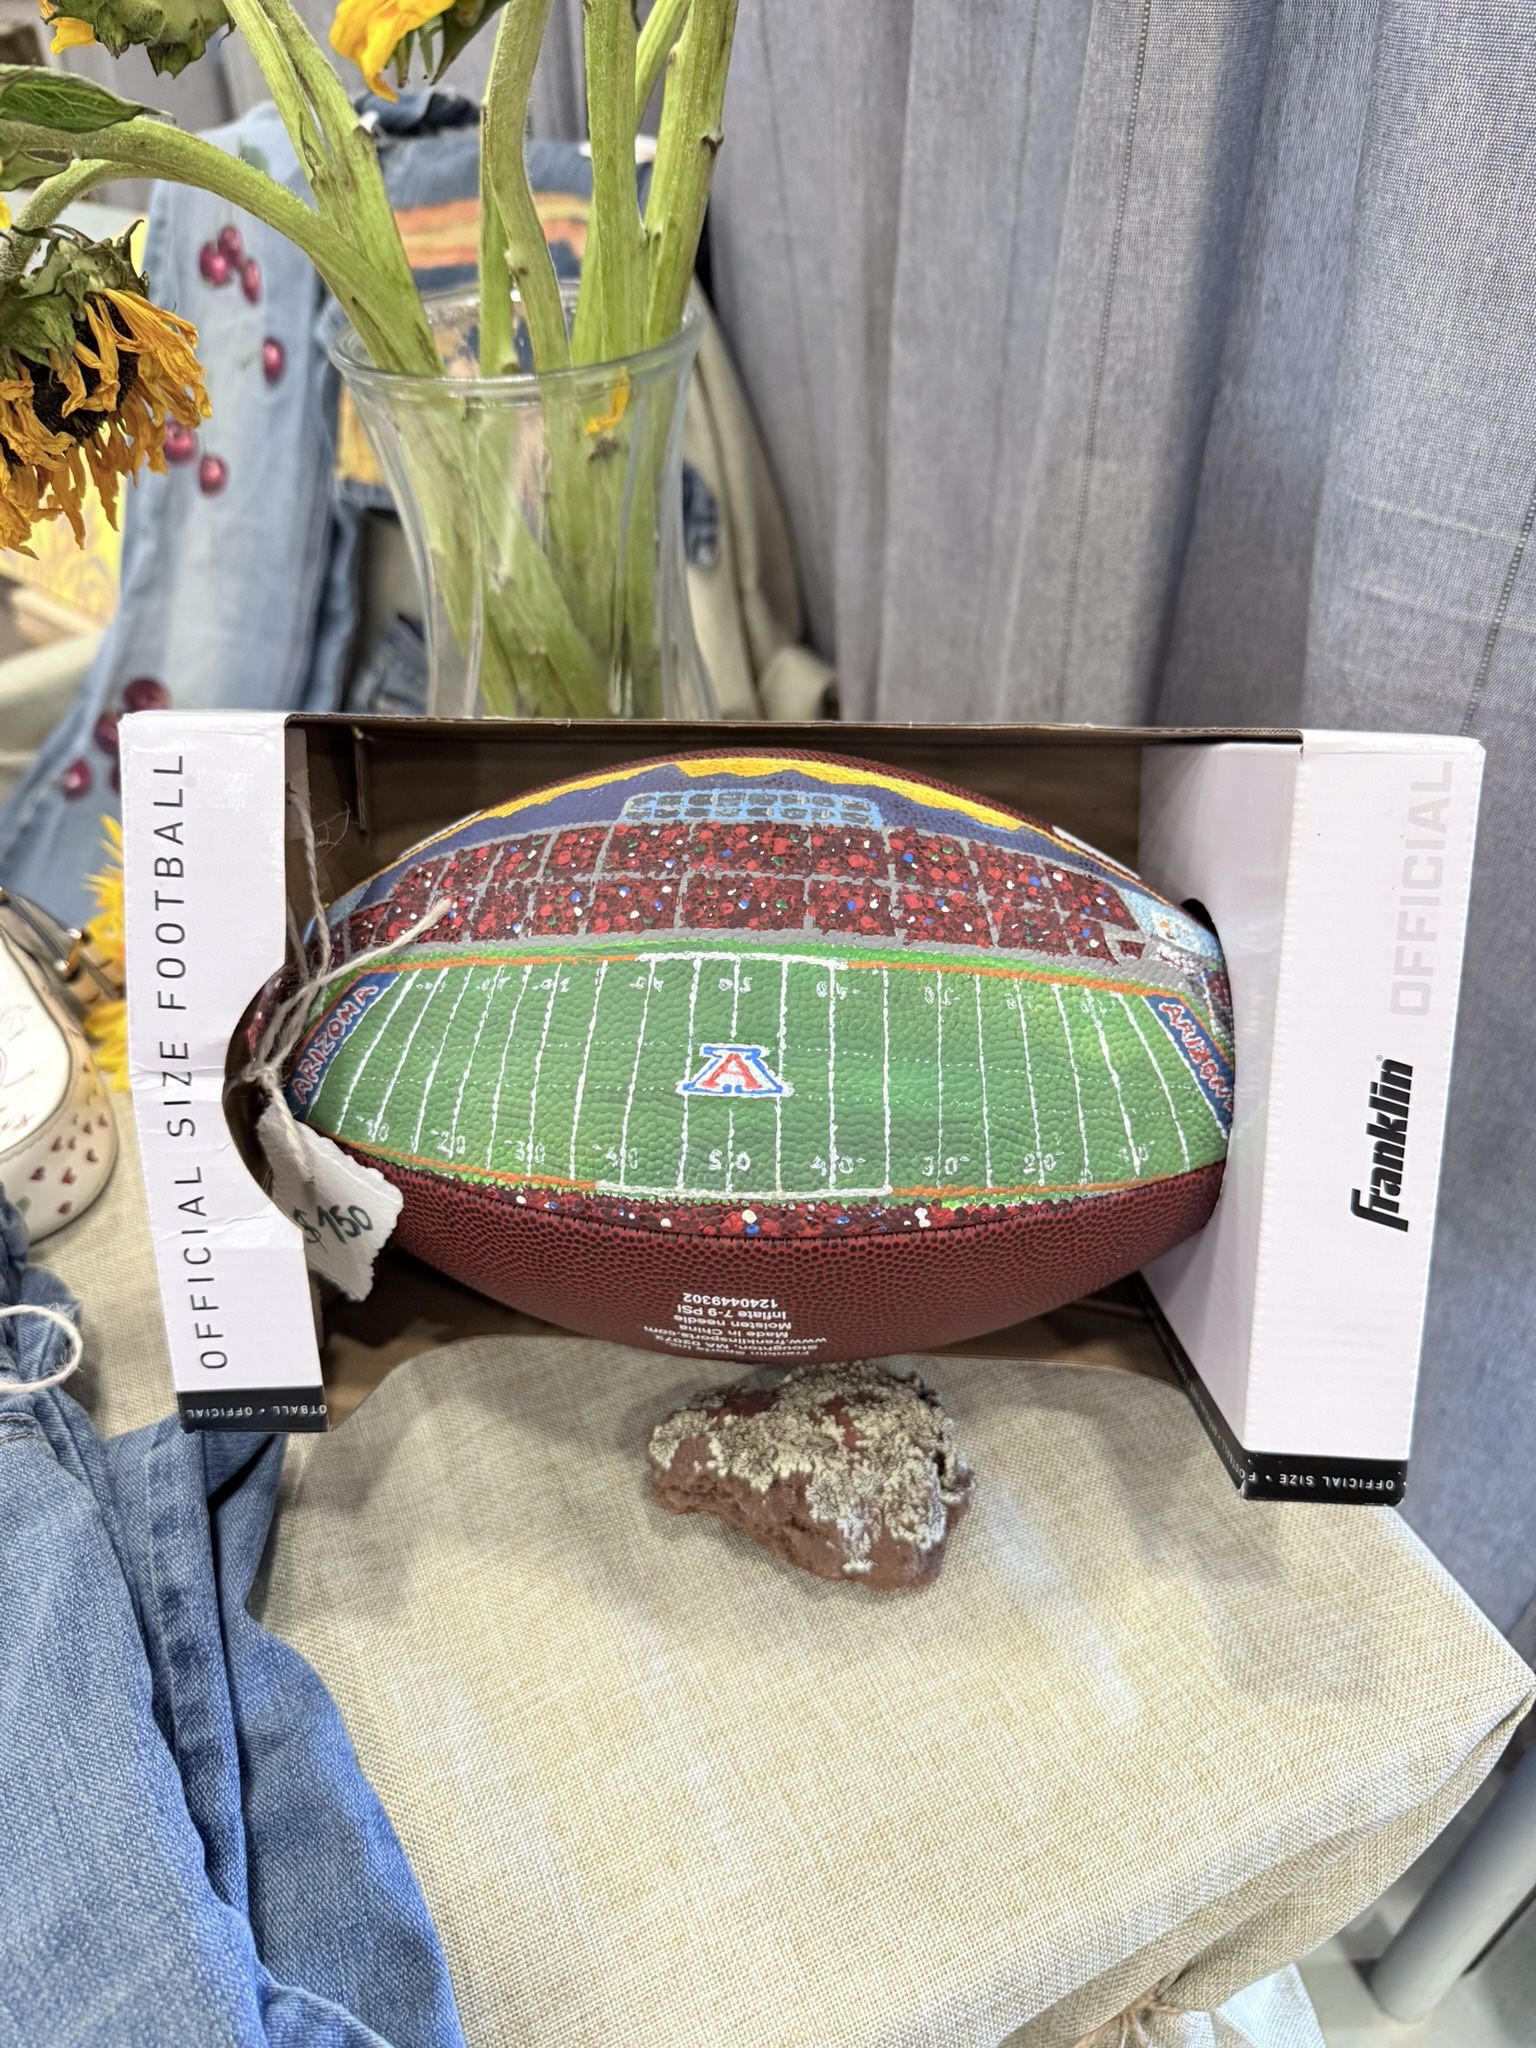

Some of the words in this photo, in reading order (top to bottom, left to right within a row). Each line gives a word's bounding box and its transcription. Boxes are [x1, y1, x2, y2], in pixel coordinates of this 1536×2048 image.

[153, 755, 189, 1011] FOOTBALL
[1390, 761, 1453, 1016] OFFICIAL
[676, 1043, 794, 1099] A
[159, 1041, 196, 1137] SIZE
[708, 1149, 751, 1171] 50
[922, 1157, 959, 1176] 30
[299, 1204, 373, 1253] $150
[175, 1166, 228, 1370] OFFICIAL
[682, 1292, 779, 1309] 1240449302
[677, 1303, 704, 1316] PSI
[707, 1307, 734, 1319] 7-9
[737, 1310, 787, 1321] Inflate
[673, 1314, 726, 1327] needle
[730, 1320, 792, 1331] Moisten
[643, 1325, 827, 1345] www.franklinsports.com
[679, 1323, 724, 1336] China
[746, 1331, 789, 1339] Made
[186, 1406, 254, 1418] OFFICIAL
[1278, 1472, 1315, 1486] SIZE
[1322, 1474, 1394, 1490] OFFICIAL
